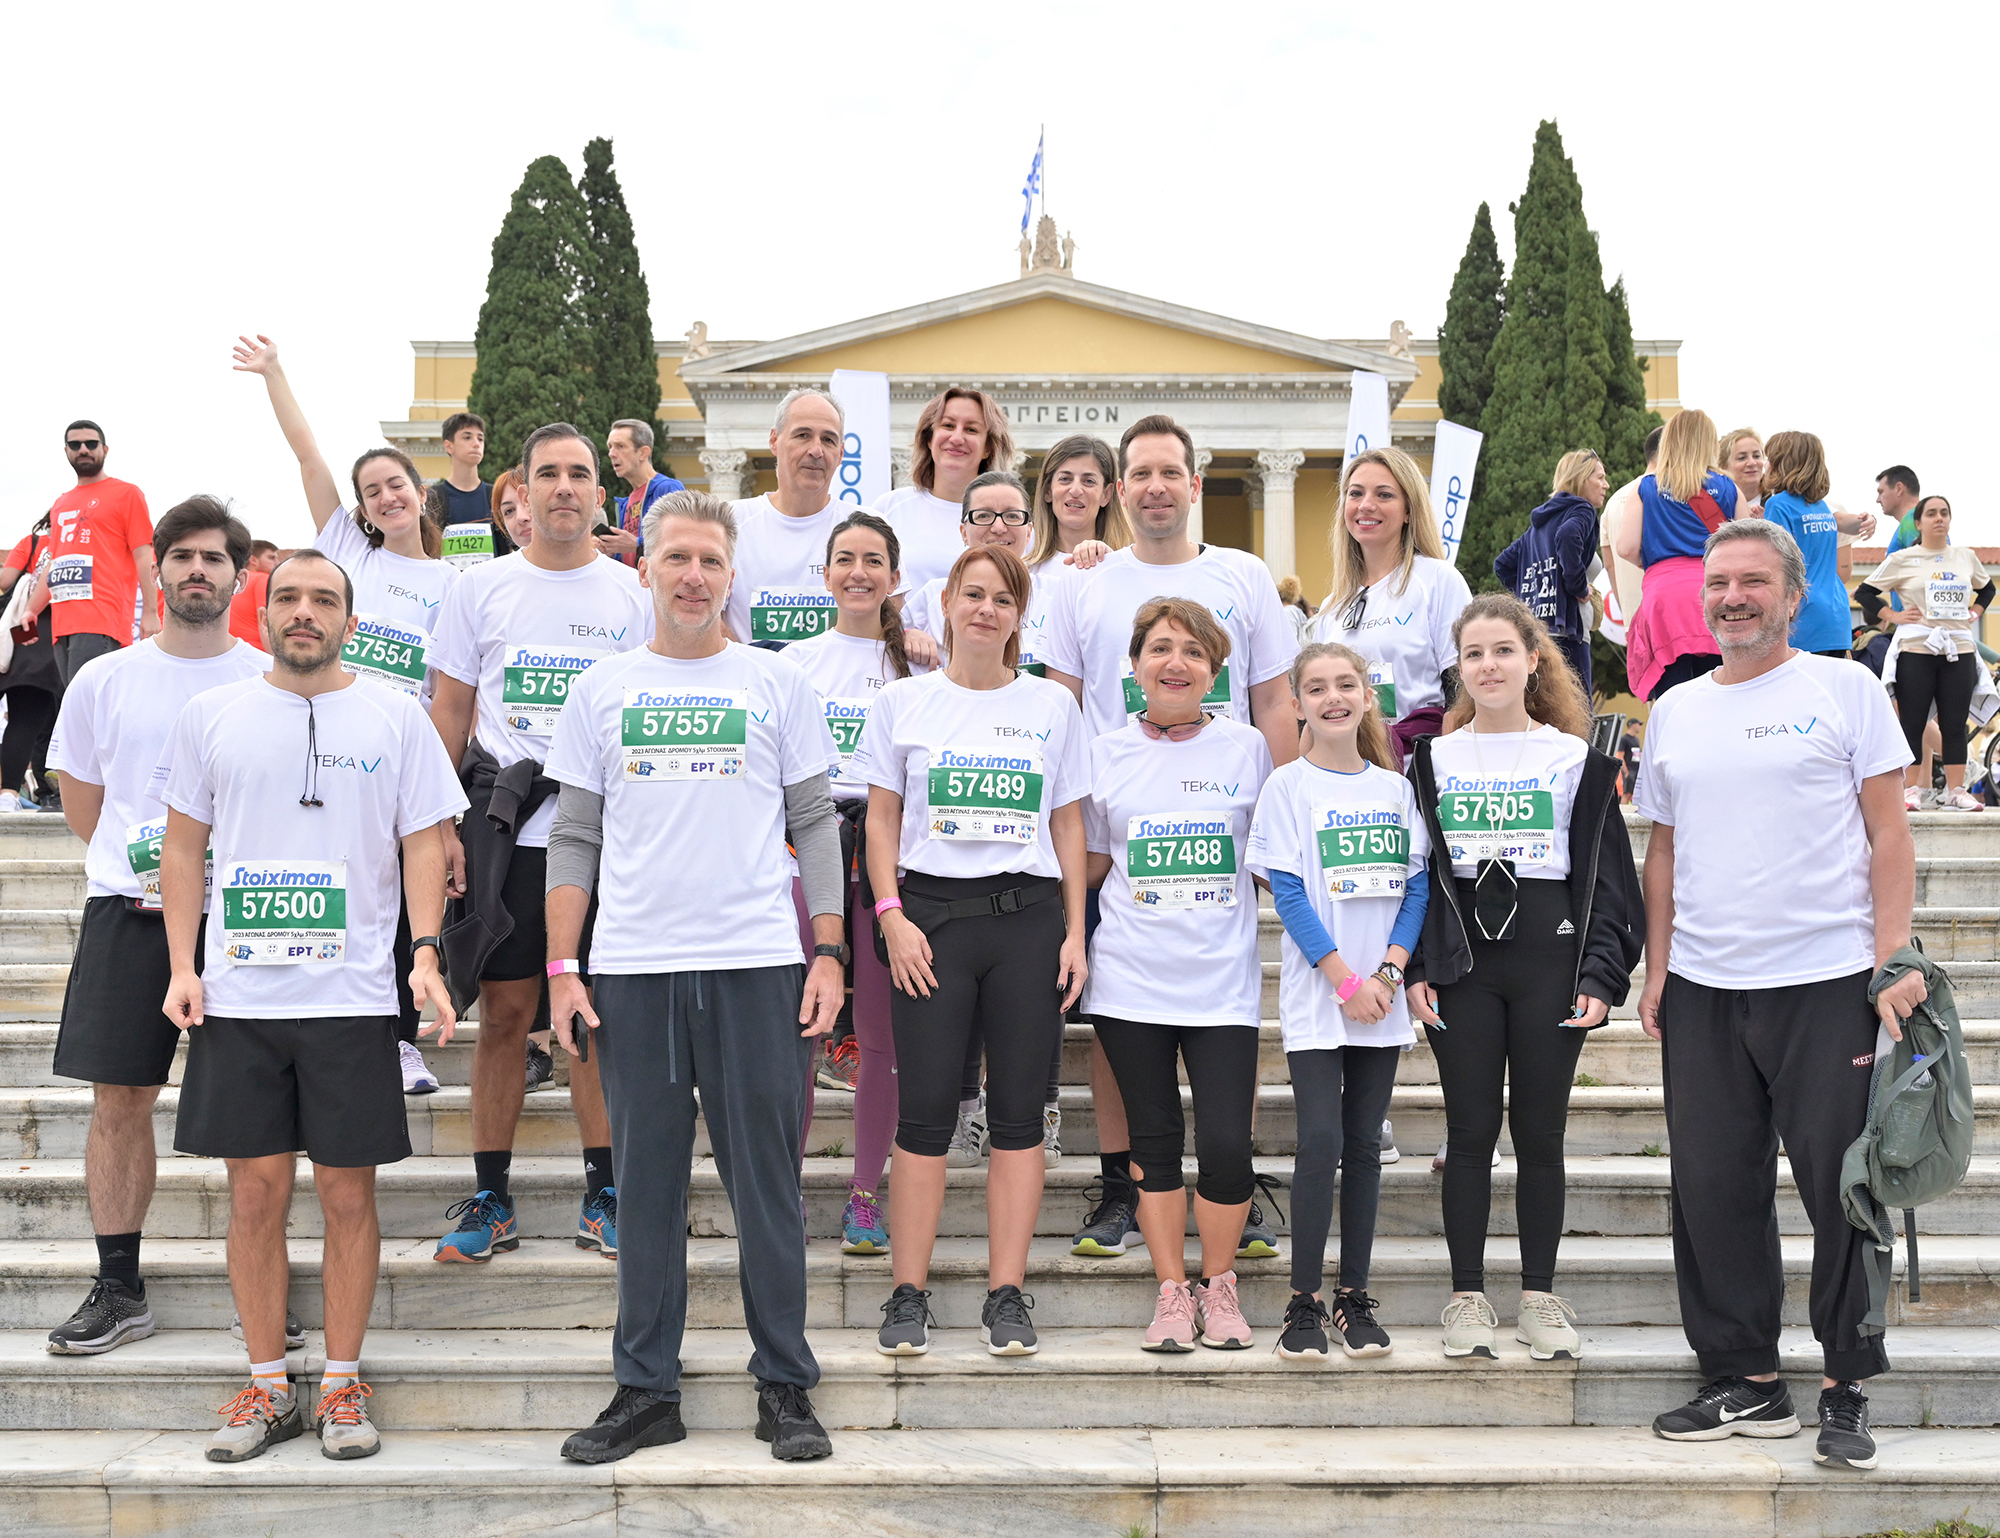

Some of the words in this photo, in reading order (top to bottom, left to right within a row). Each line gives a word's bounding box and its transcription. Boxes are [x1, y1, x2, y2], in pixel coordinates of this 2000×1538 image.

[1001, 406, 1118, 422] ΑΠΠΕΙΟΝ
[448, 537, 484, 551] 71427
[51, 567, 82, 583] 67472
[388, 584, 418, 602] TEKA
[756, 591, 836, 606] Stoiximan
[1934, 591, 1964, 603] 65330
[766, 610, 830, 633] 57491
[1362, 617, 1391, 630] TEKA
[358, 621, 422, 646] oiximan
[568, 624, 608, 638] TEKA
[345, 634, 413, 669] 57554
[632, 692, 733, 707] Stoiximan
[642, 710, 726, 736] 57557
[994, 726, 1033, 740] TEKA
[1745, 724, 1789, 739] TEKA
[313, 755, 356, 769] TEKA
[691, 762, 715, 772] ΕΡΤ
[937, 750, 1032, 771] Stoiximan
[948, 772, 1026, 801] 57489
[1181, 781, 1221, 793] TEKA
[1443, 776, 1539, 792] Stoiximan
[1452, 794, 1534, 822] 57505
[994, 824, 1016, 834] ΕΡΤ
[1136, 820, 1226, 838] Stoiximan
[1338, 828, 1402, 856] 57507
[1146, 839, 1222, 868] 57488
[1502, 847, 1524, 857] ΕΡΤ
[230, 867, 332, 886] Stoiximan
[1195, 891, 1215, 901] ΕΡΤ
[242, 891, 326, 920] 57500
[288, 947, 313, 956] ΕΡΤ
